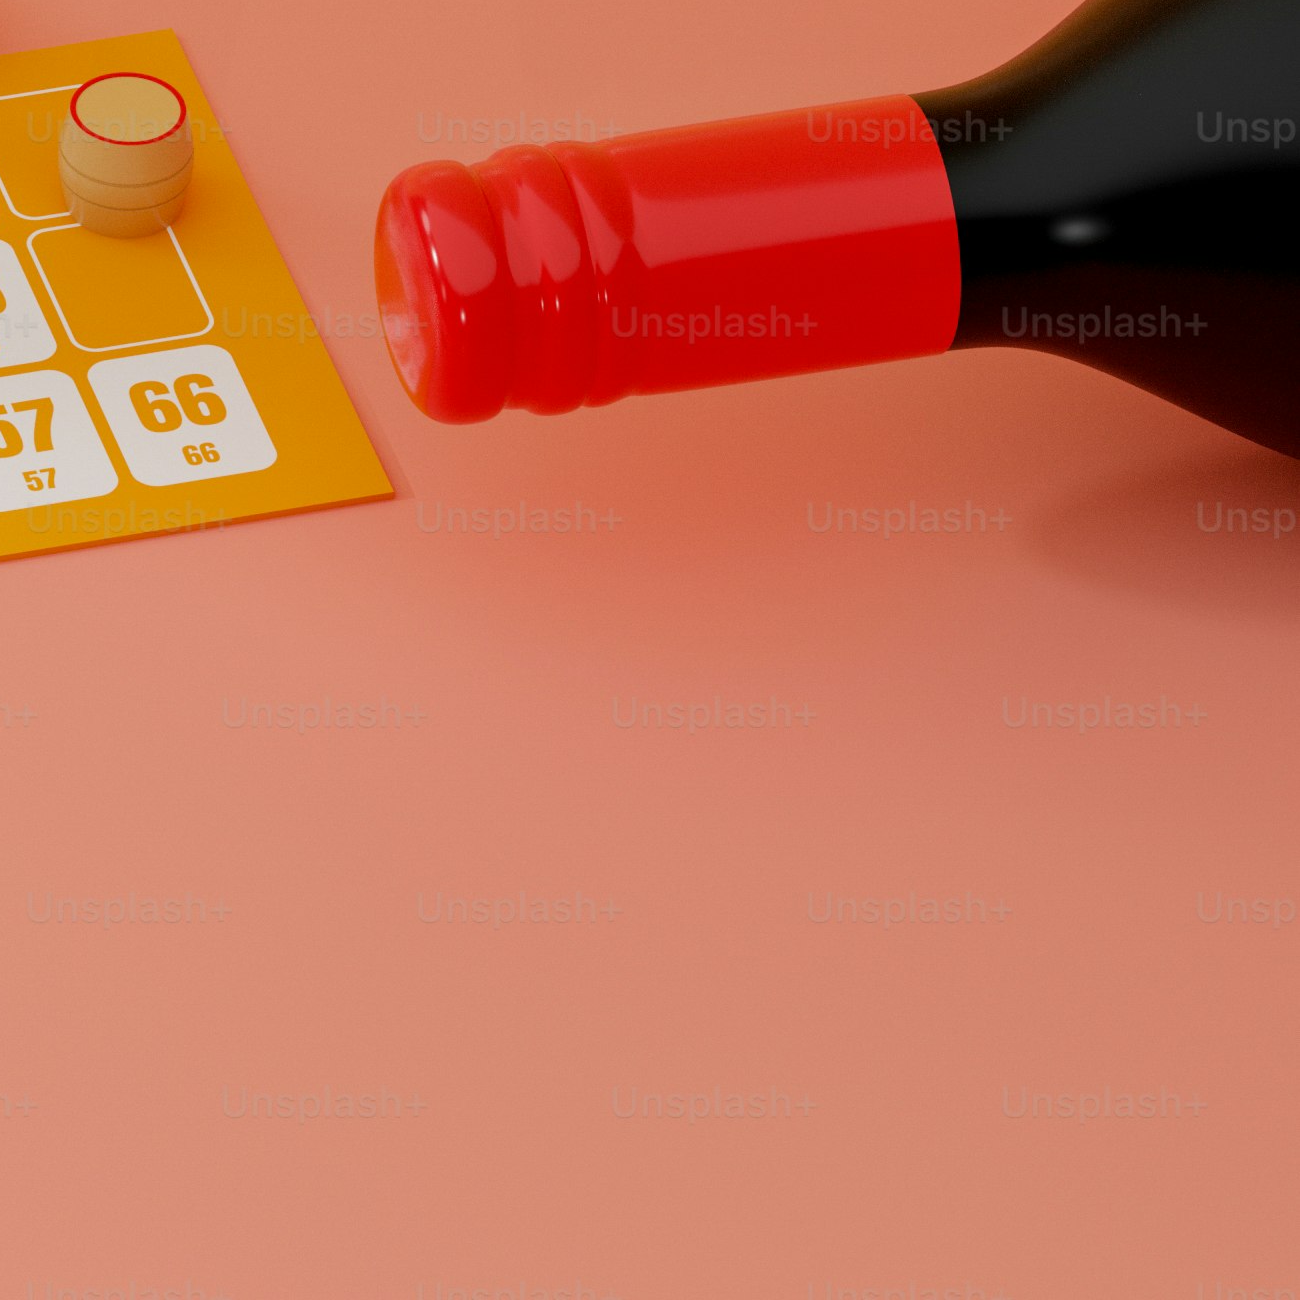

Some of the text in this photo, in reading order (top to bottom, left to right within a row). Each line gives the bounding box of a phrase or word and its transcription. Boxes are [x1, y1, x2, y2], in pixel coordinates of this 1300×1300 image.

[128, 373, 228, 433] 66
[181, 441, 221, 467] 66
[22, 467, 56, 492] 57
